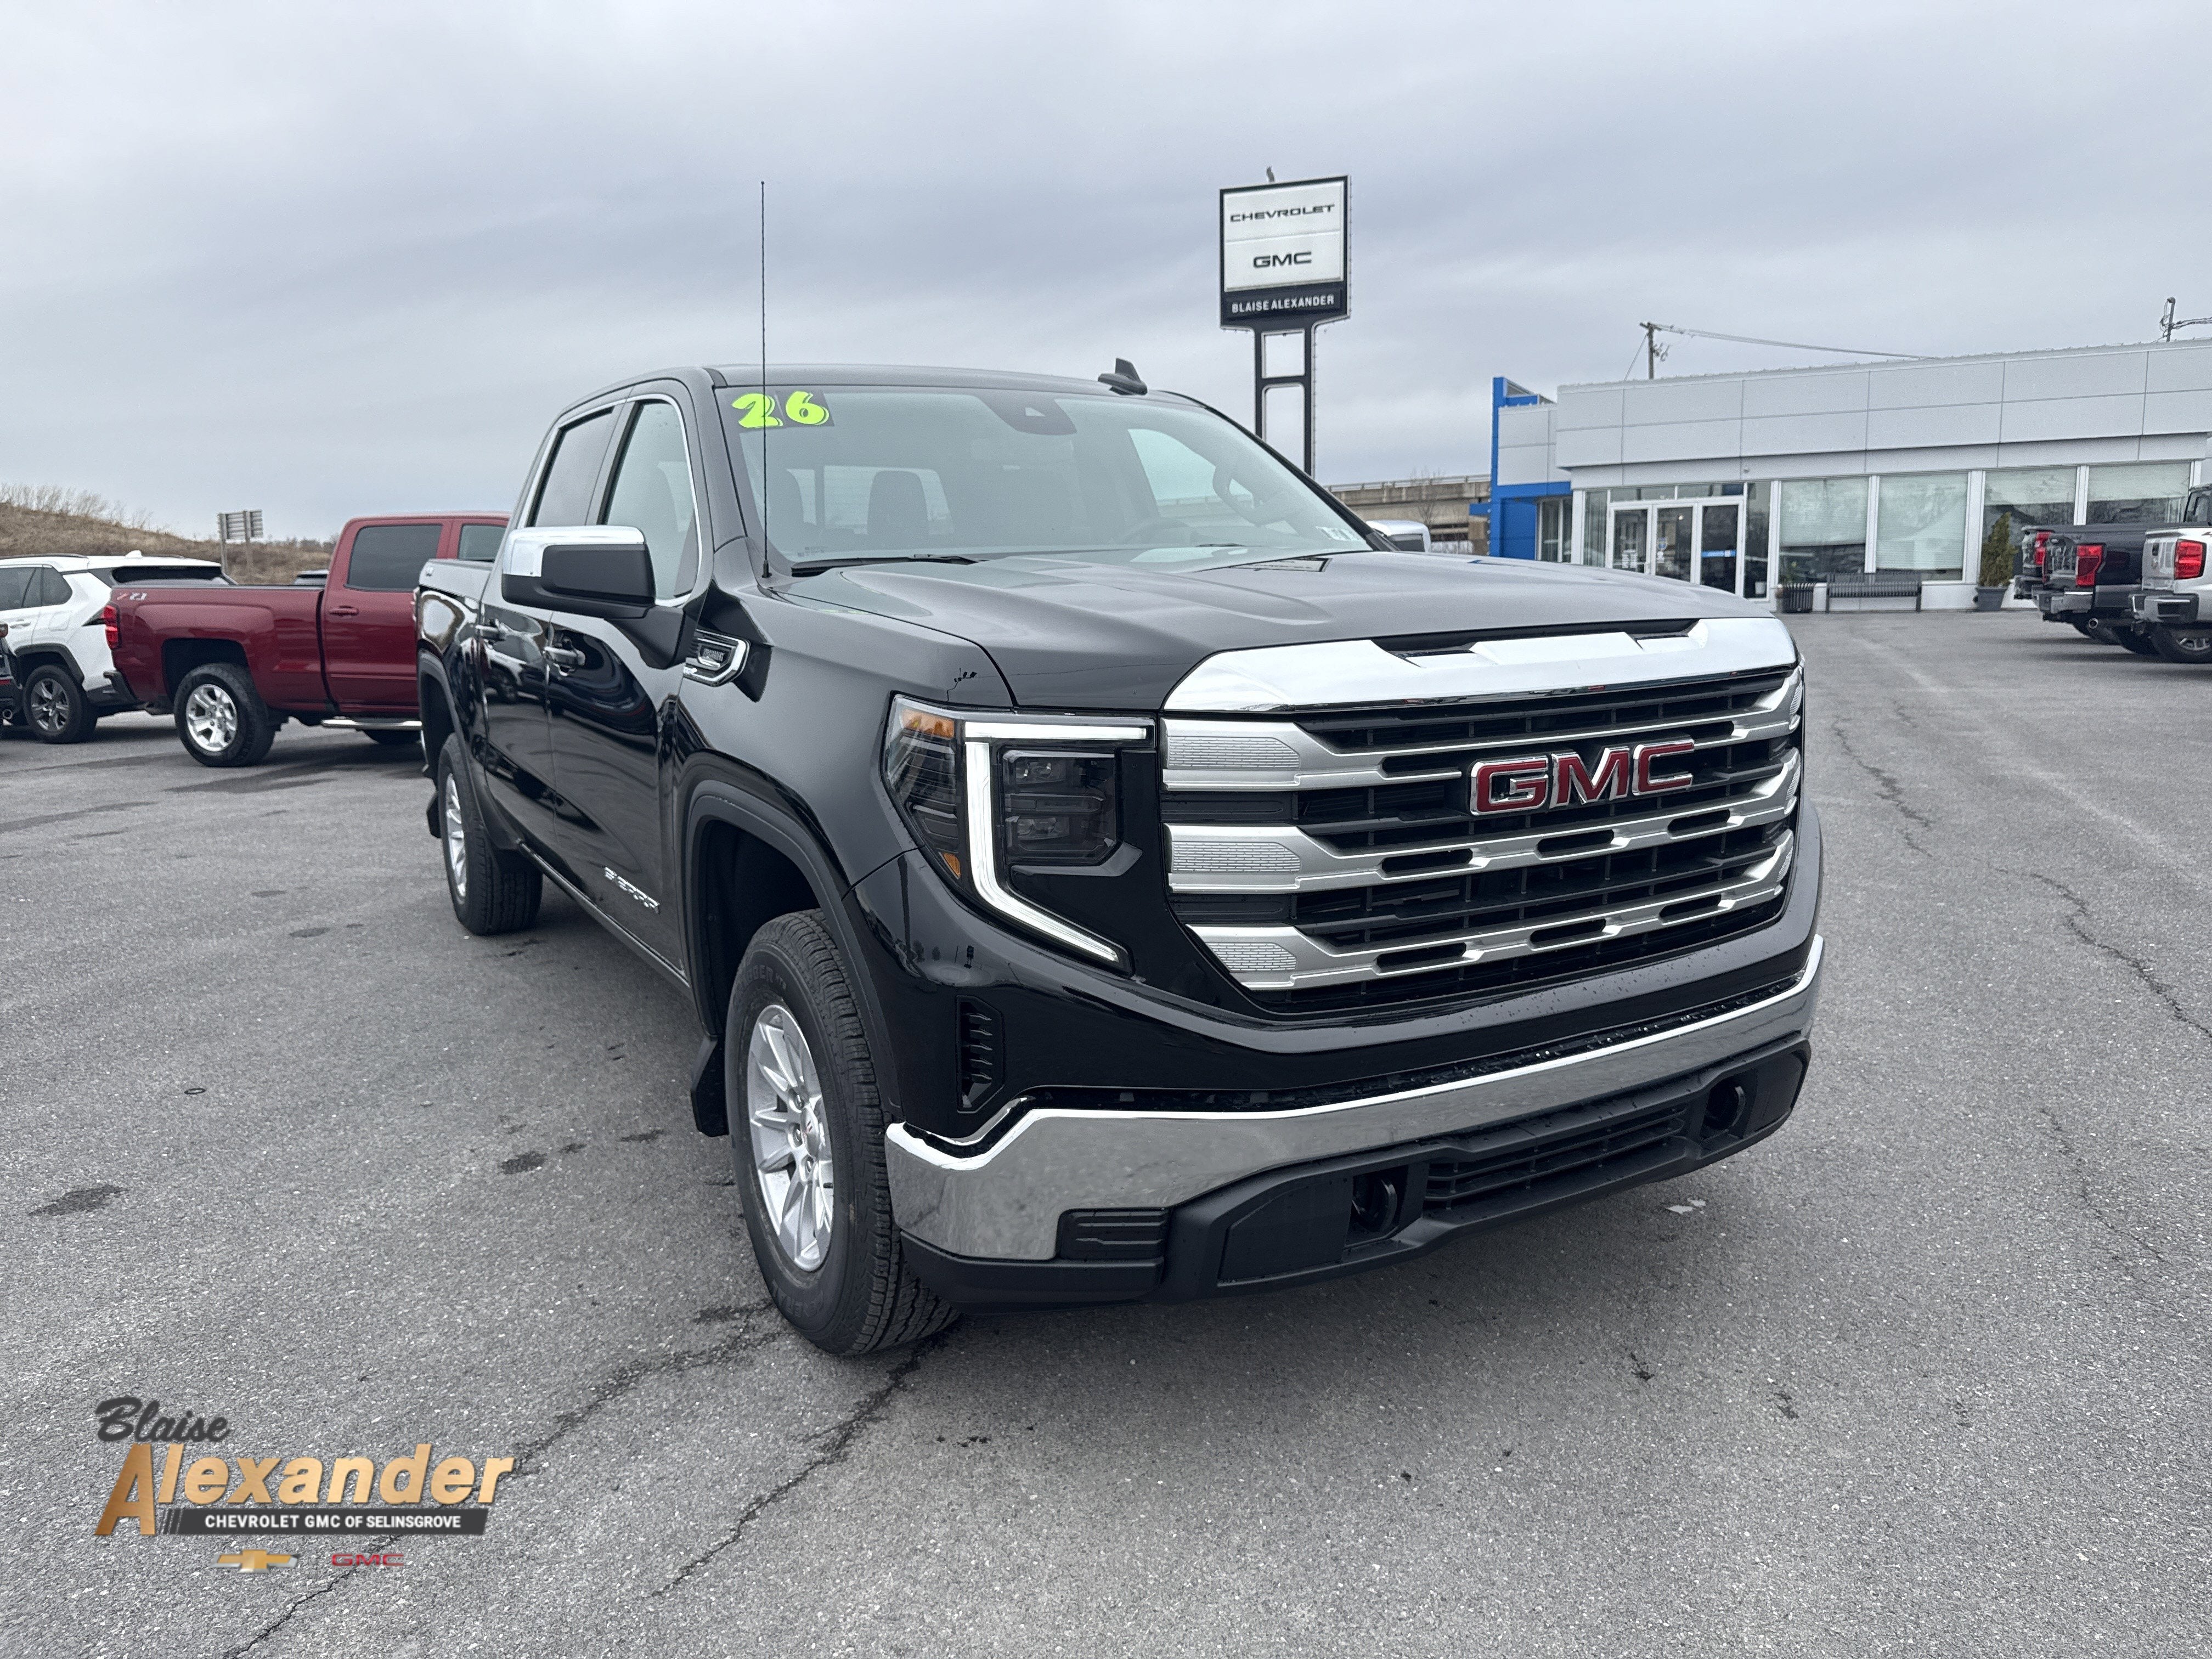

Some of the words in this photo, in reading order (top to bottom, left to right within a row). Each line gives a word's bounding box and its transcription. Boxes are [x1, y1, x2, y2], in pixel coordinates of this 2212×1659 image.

[1230, 204, 1335, 222] CHEVROLET
[1253, 251, 1312, 268] GMC
[1232, 301, 1269, 313] BLAISE
[1271, 294, 1334, 309] ALEXANDER
[732, 391, 829, 428] 26
[1469, 738, 1695, 816] GMC
